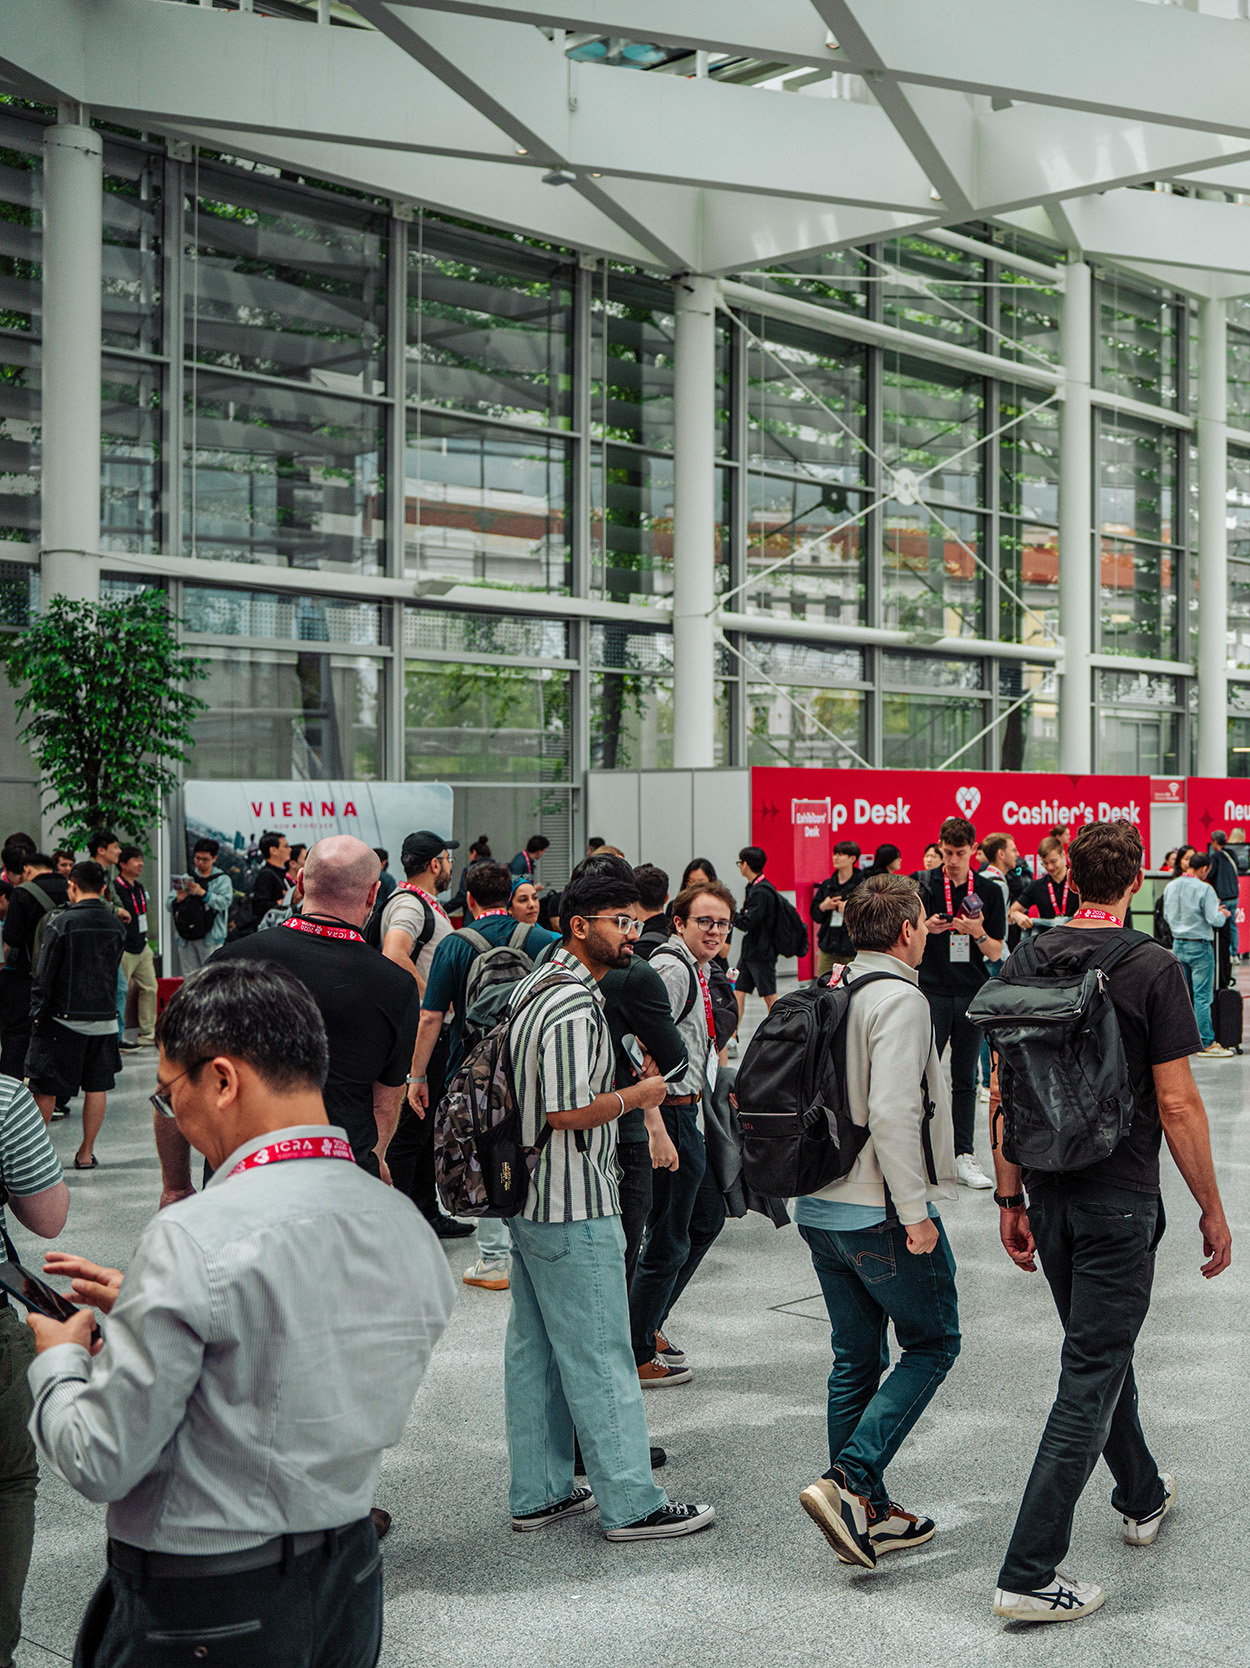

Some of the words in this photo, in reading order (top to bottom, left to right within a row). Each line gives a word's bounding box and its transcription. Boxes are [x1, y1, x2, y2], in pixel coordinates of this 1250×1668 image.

[251, 801, 358, 818] VIENNA
[854, 797, 911, 825] Desk
[1002, 799, 1094, 825] Cashier's
[1098, 799, 1141, 824] Desk
[804, 825, 820, 838] Desk
[327, 930, 347, 939] ICRA
[274, 1140, 313, 1153] ICRA
